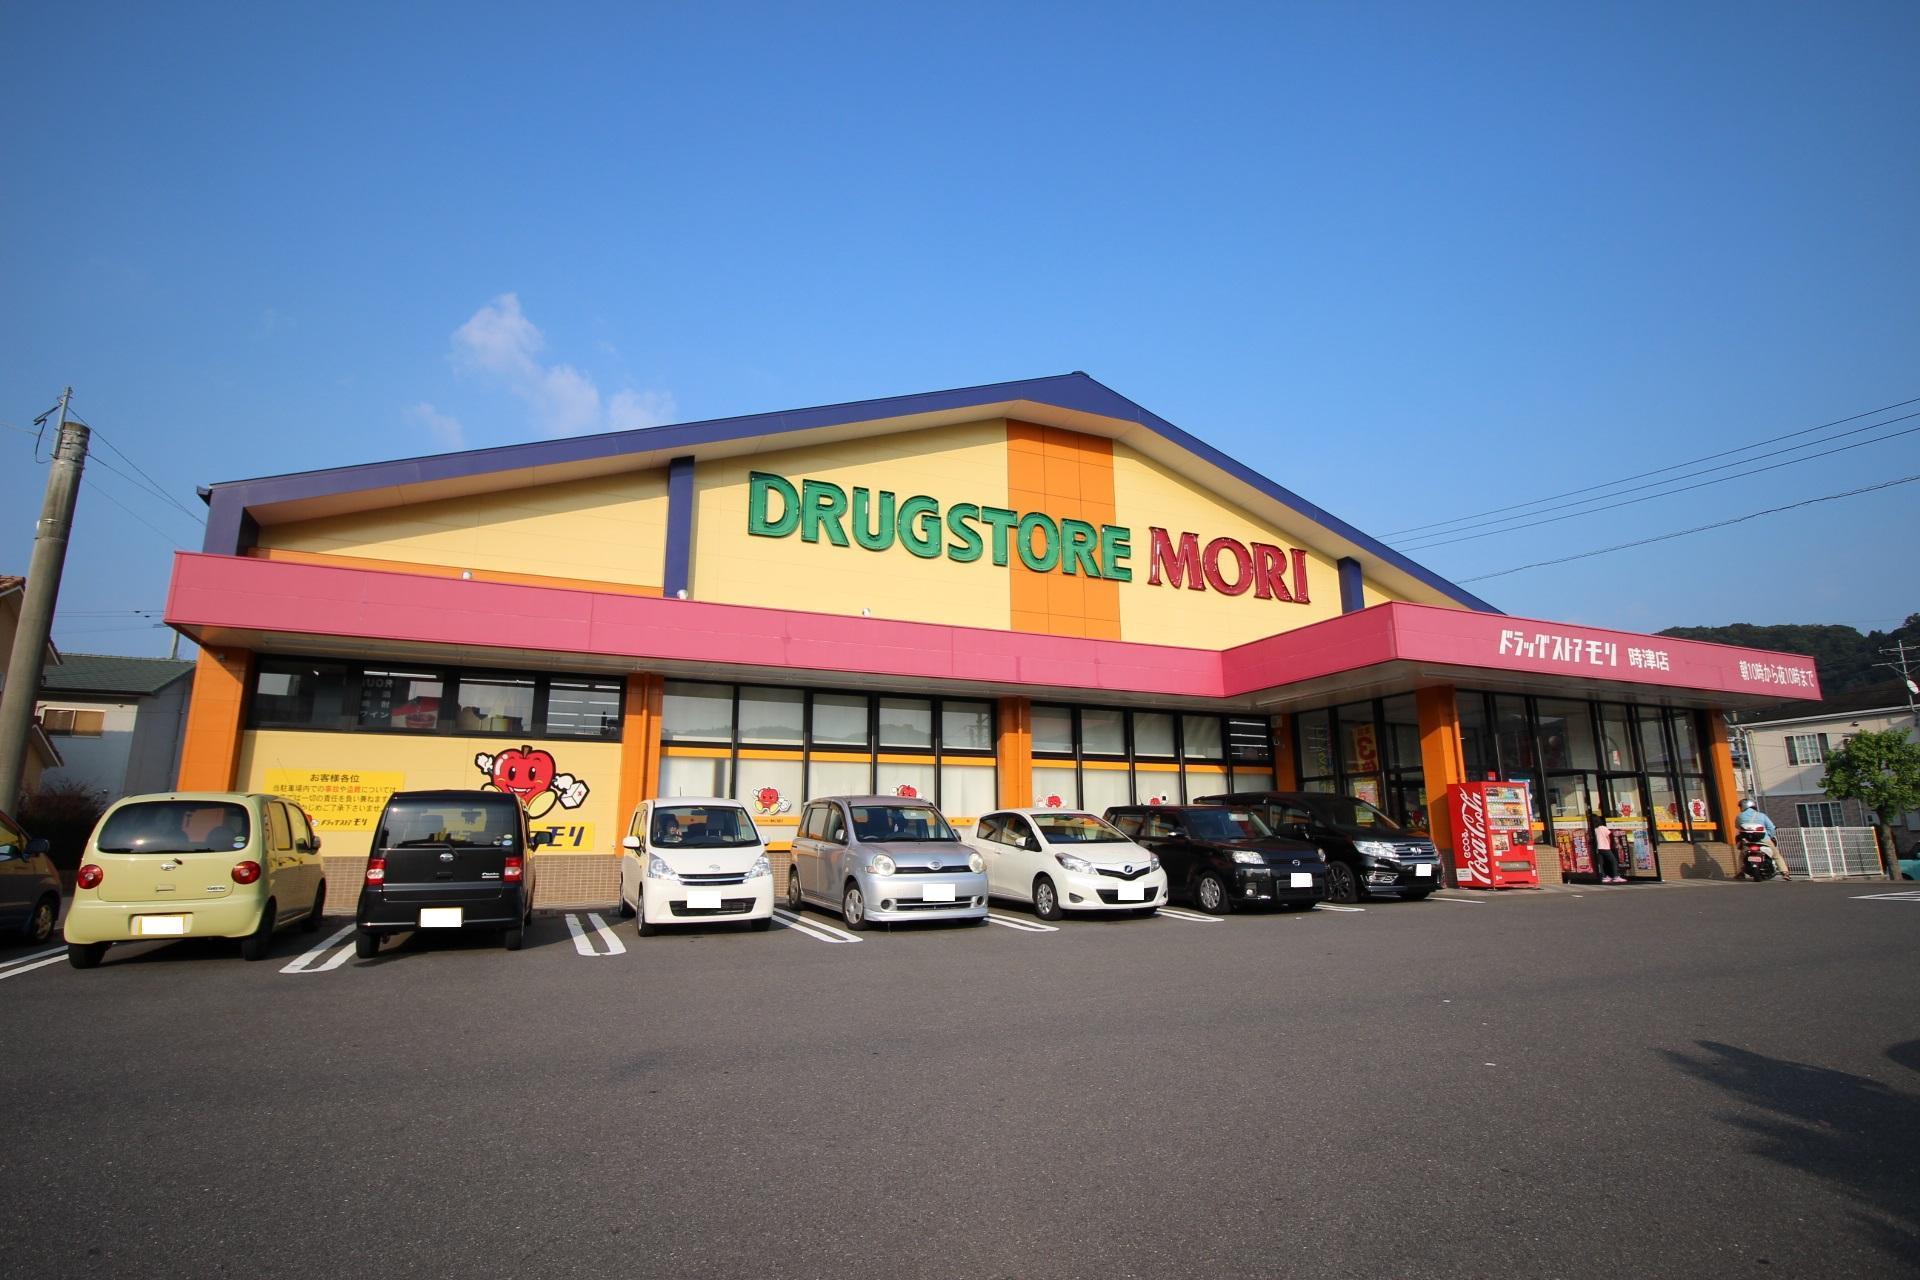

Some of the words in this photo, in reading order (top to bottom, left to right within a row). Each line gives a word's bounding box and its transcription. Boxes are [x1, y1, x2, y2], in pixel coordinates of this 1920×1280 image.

[748, 470, 1133, 582] DRUGSTORE
[1147, 526, 1311, 605] MORI
[1627, 647, 1670, 671] 時津店
[1738, 659, 1815, 688] 朝10時から夜10時まで
[310, 773, 360, 783] お客様各位
